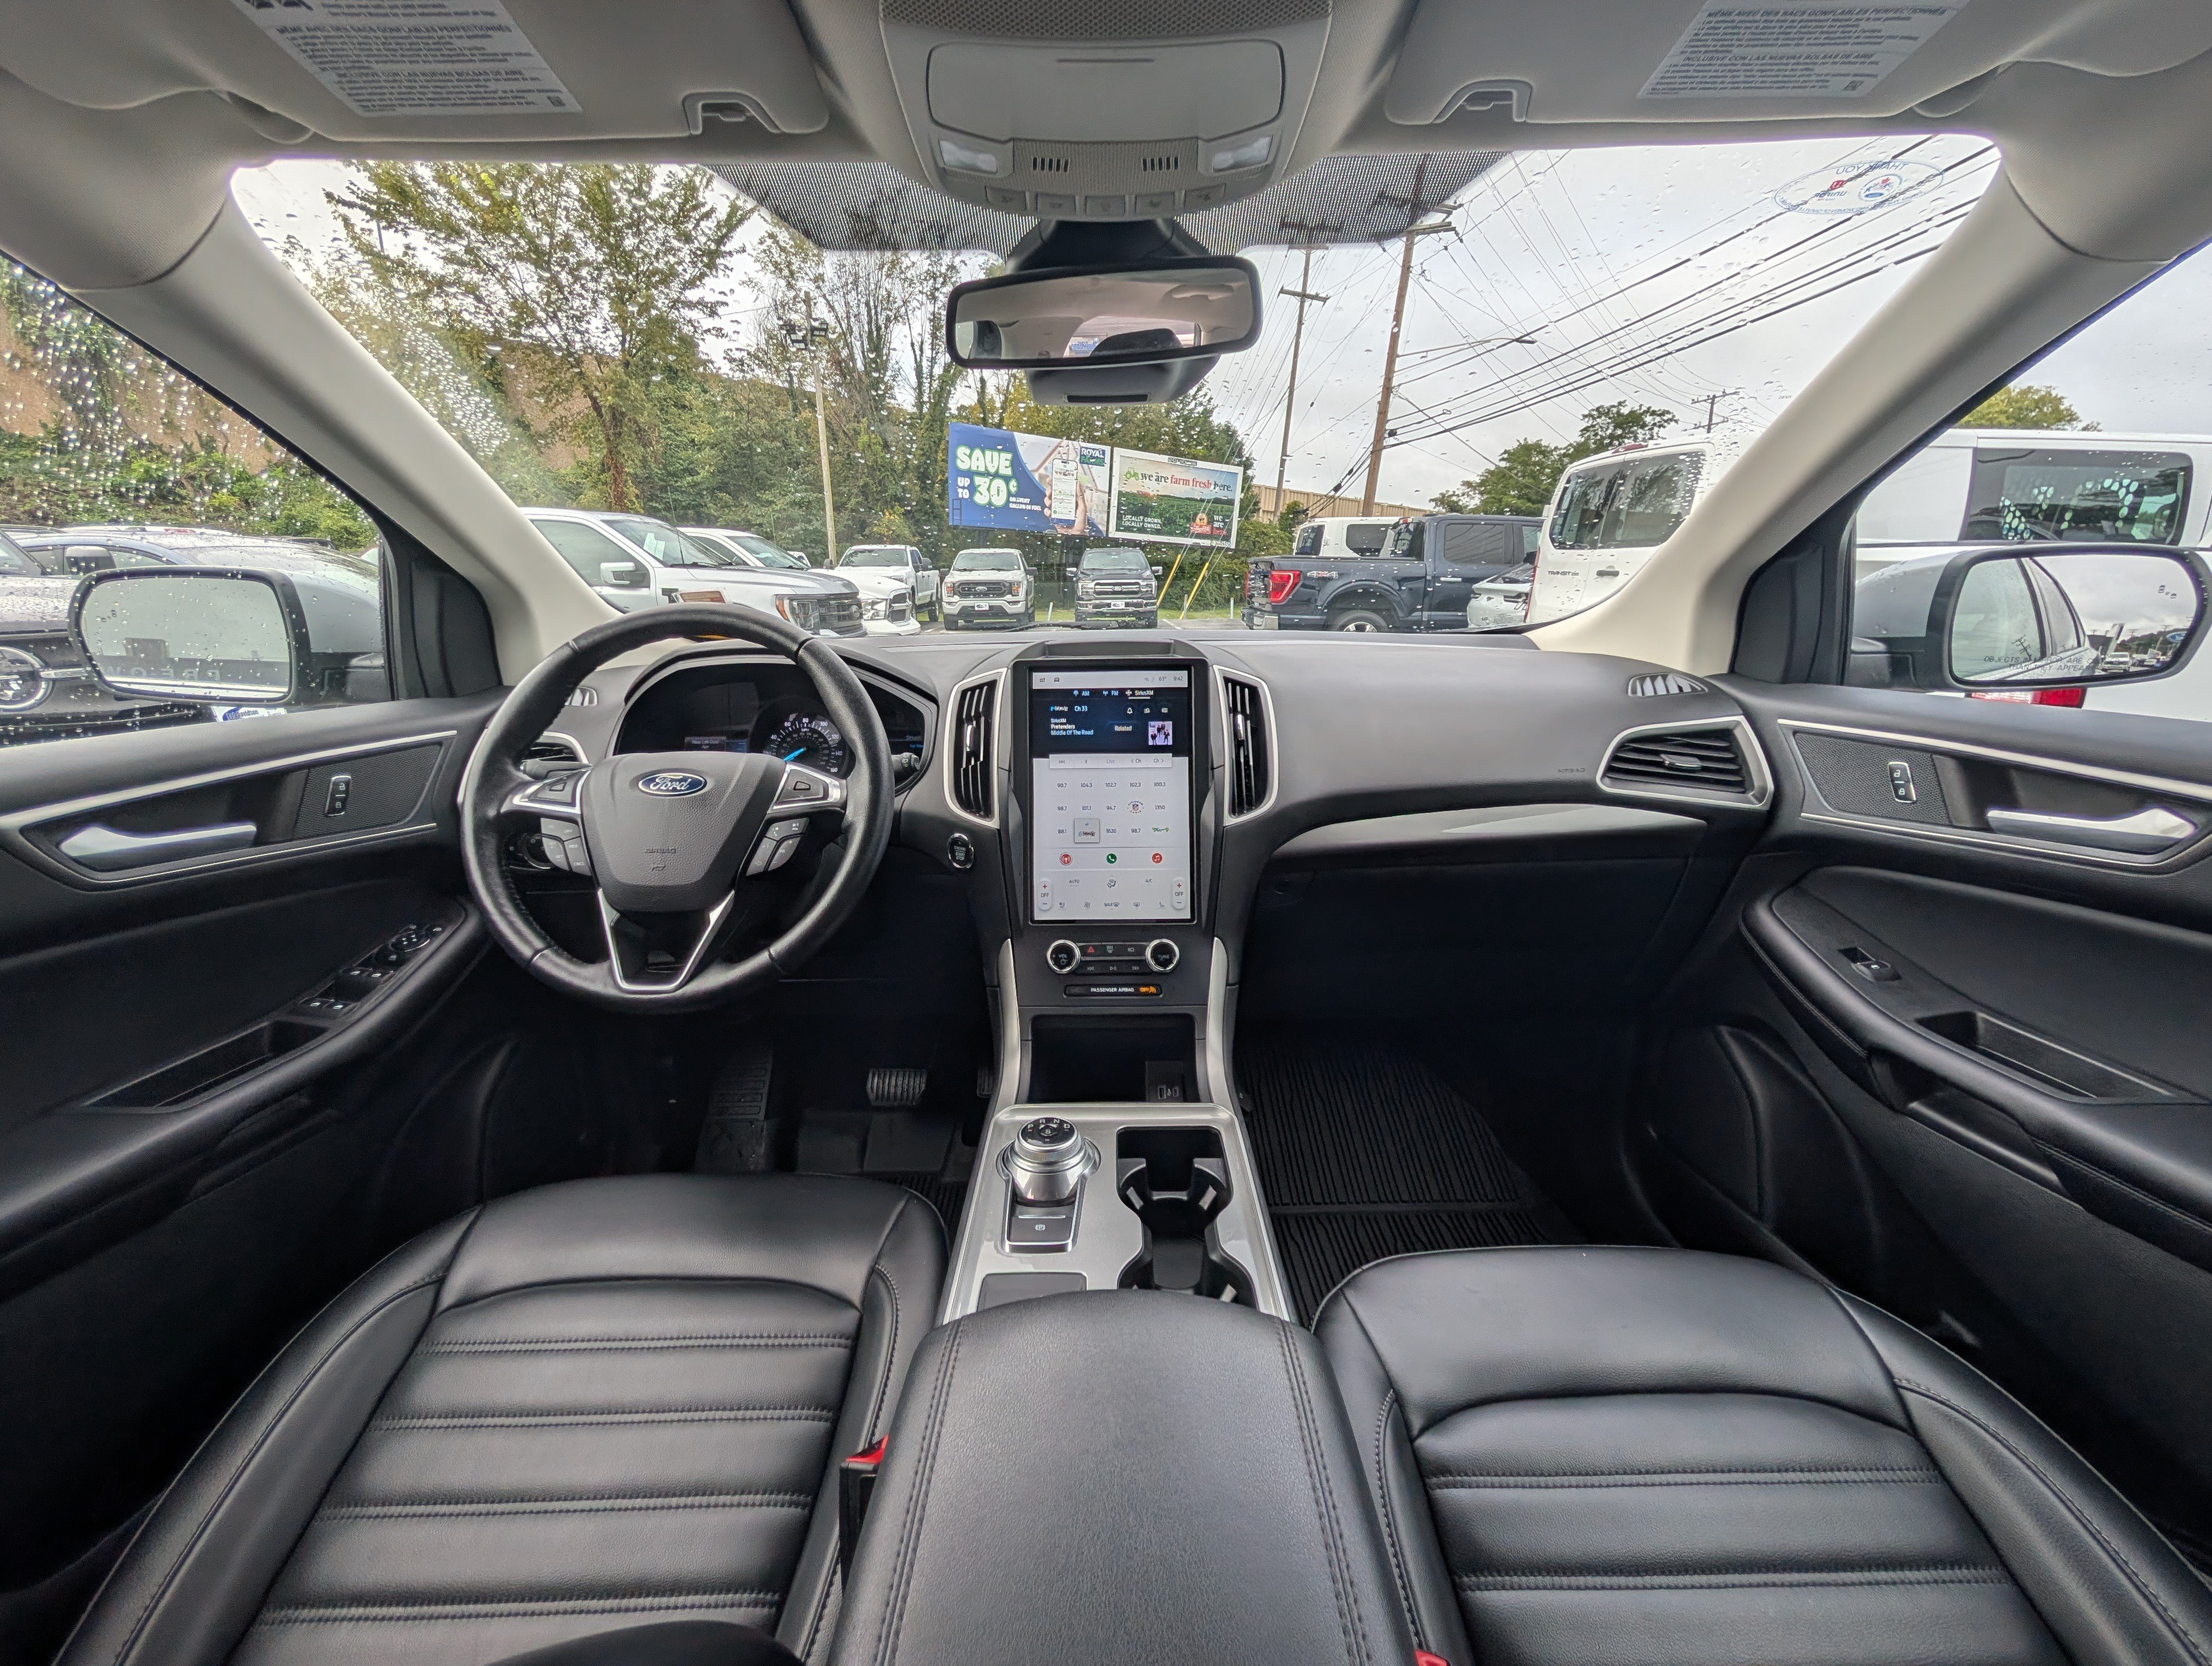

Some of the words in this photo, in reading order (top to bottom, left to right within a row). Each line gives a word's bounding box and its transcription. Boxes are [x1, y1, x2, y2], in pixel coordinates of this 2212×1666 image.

[1081, 447, 1104, 458] ROYAL
[956, 445, 1013, 476] SAVE
[957, 477, 970, 487] UP
[1140, 473, 1153, 481] we
[1155, 473, 1169, 484] are
[1170, 475, 1190, 486] farm
[1192, 478, 1212, 489] fresh
[1213, 480, 1233, 492] here.
[957, 488, 970, 498] TO
[650, 775, 692, 790] Ford
